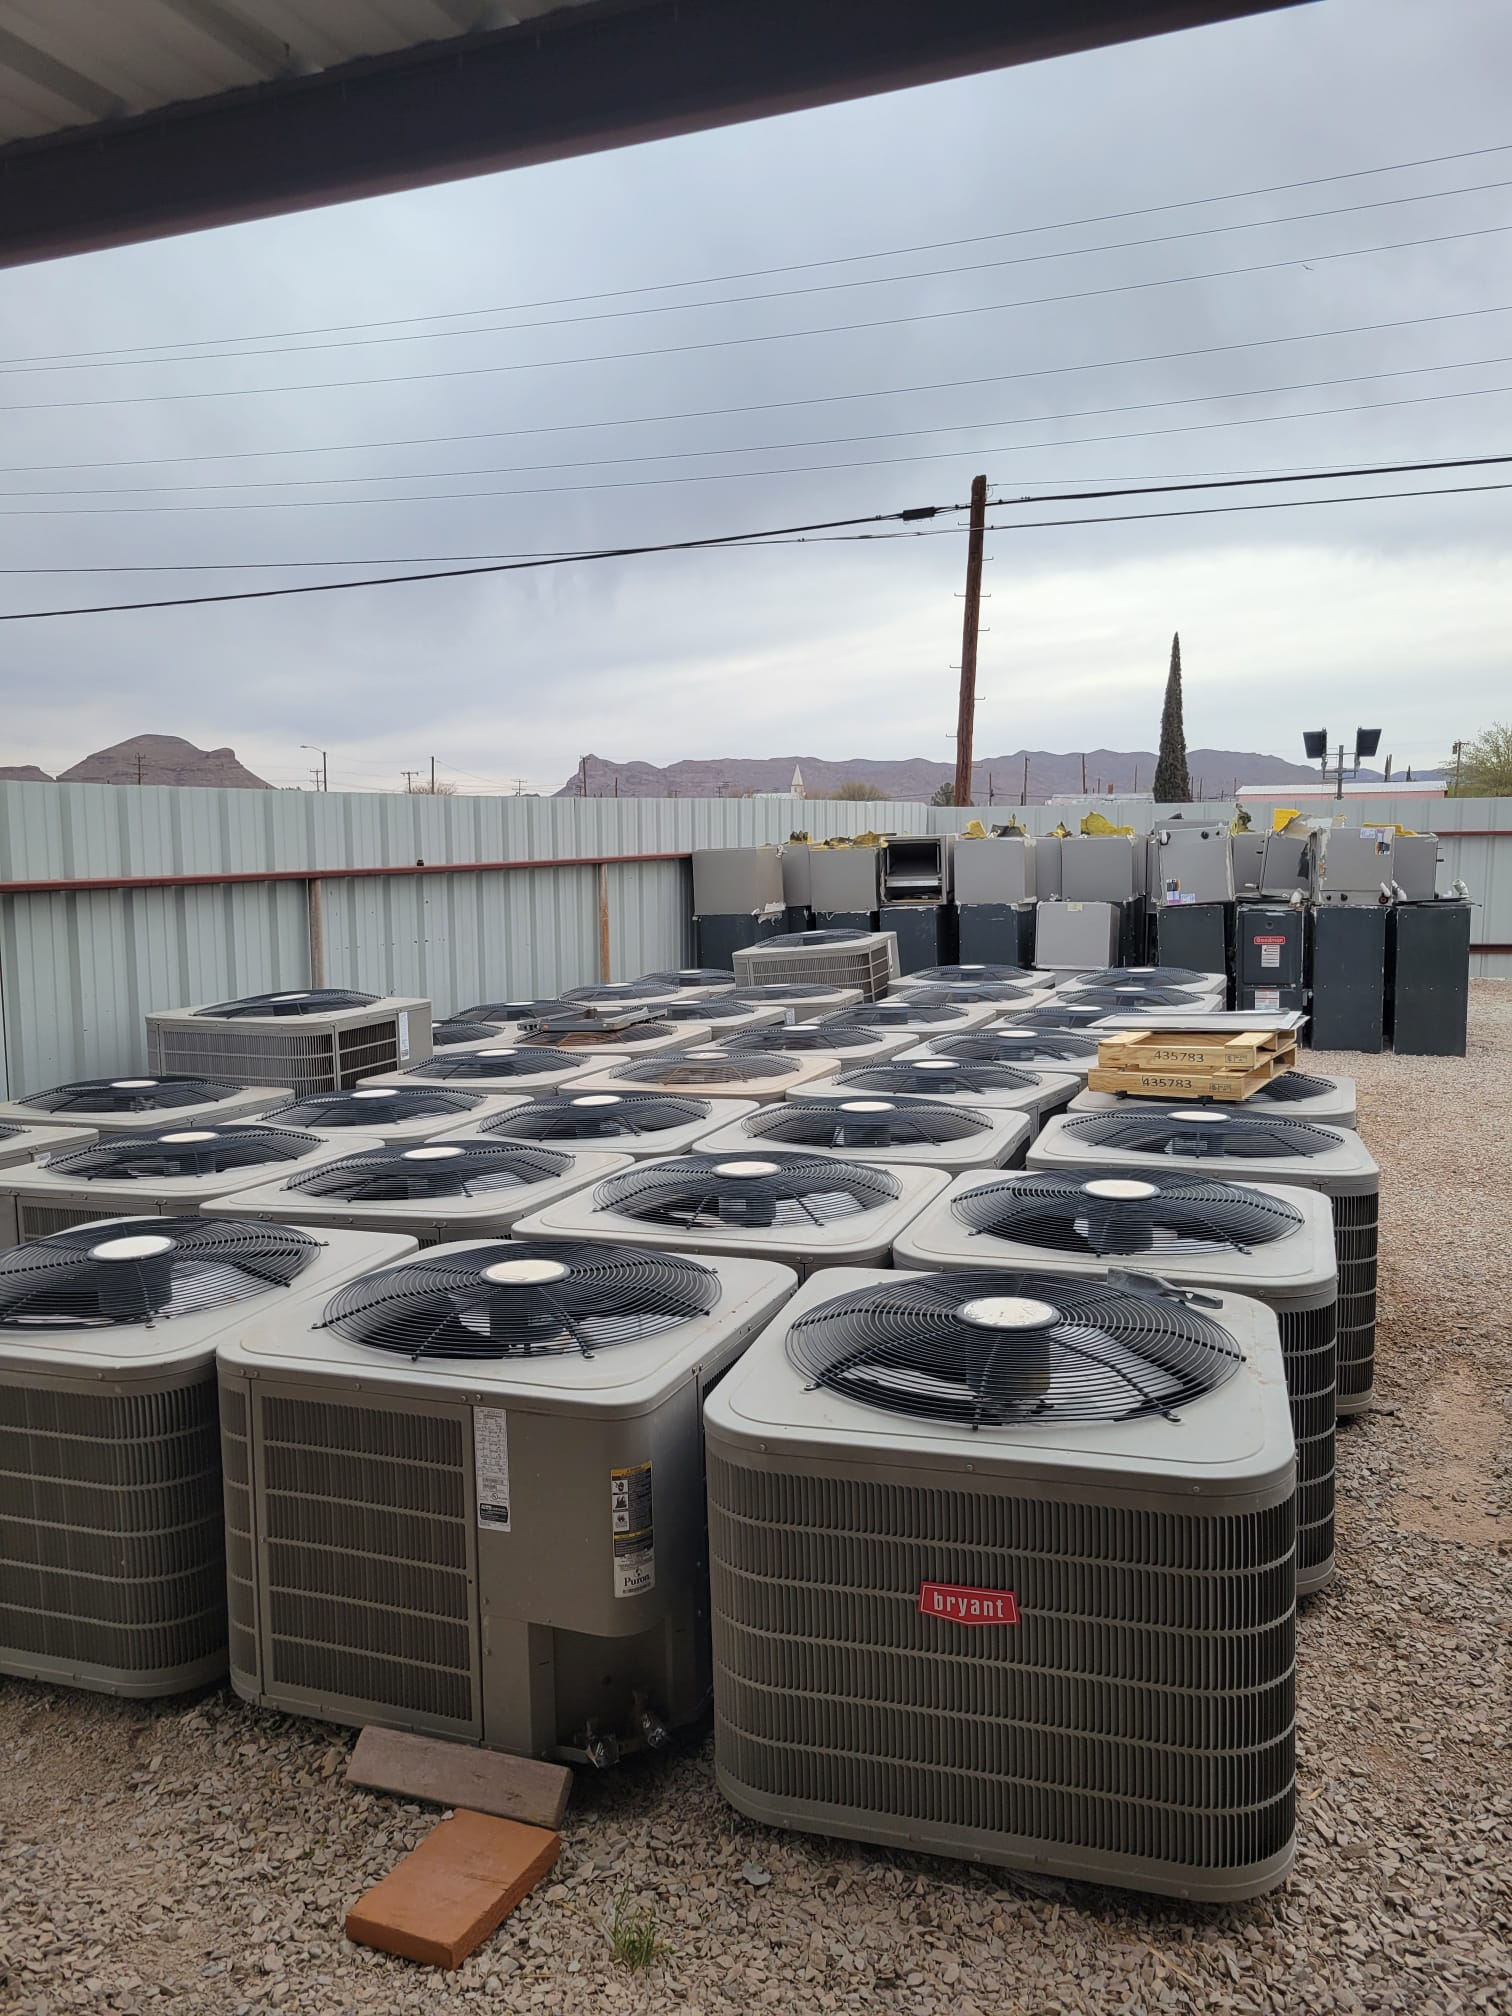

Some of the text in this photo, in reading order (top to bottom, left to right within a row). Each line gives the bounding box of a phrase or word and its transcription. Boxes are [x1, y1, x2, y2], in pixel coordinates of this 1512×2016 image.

[1154, 1051, 1204, 1062] 435783
[1142, 1078, 1192, 1088] 435783
[624, 1574, 650, 1586] Puron
[933, 1591, 1004, 1618] bryant
